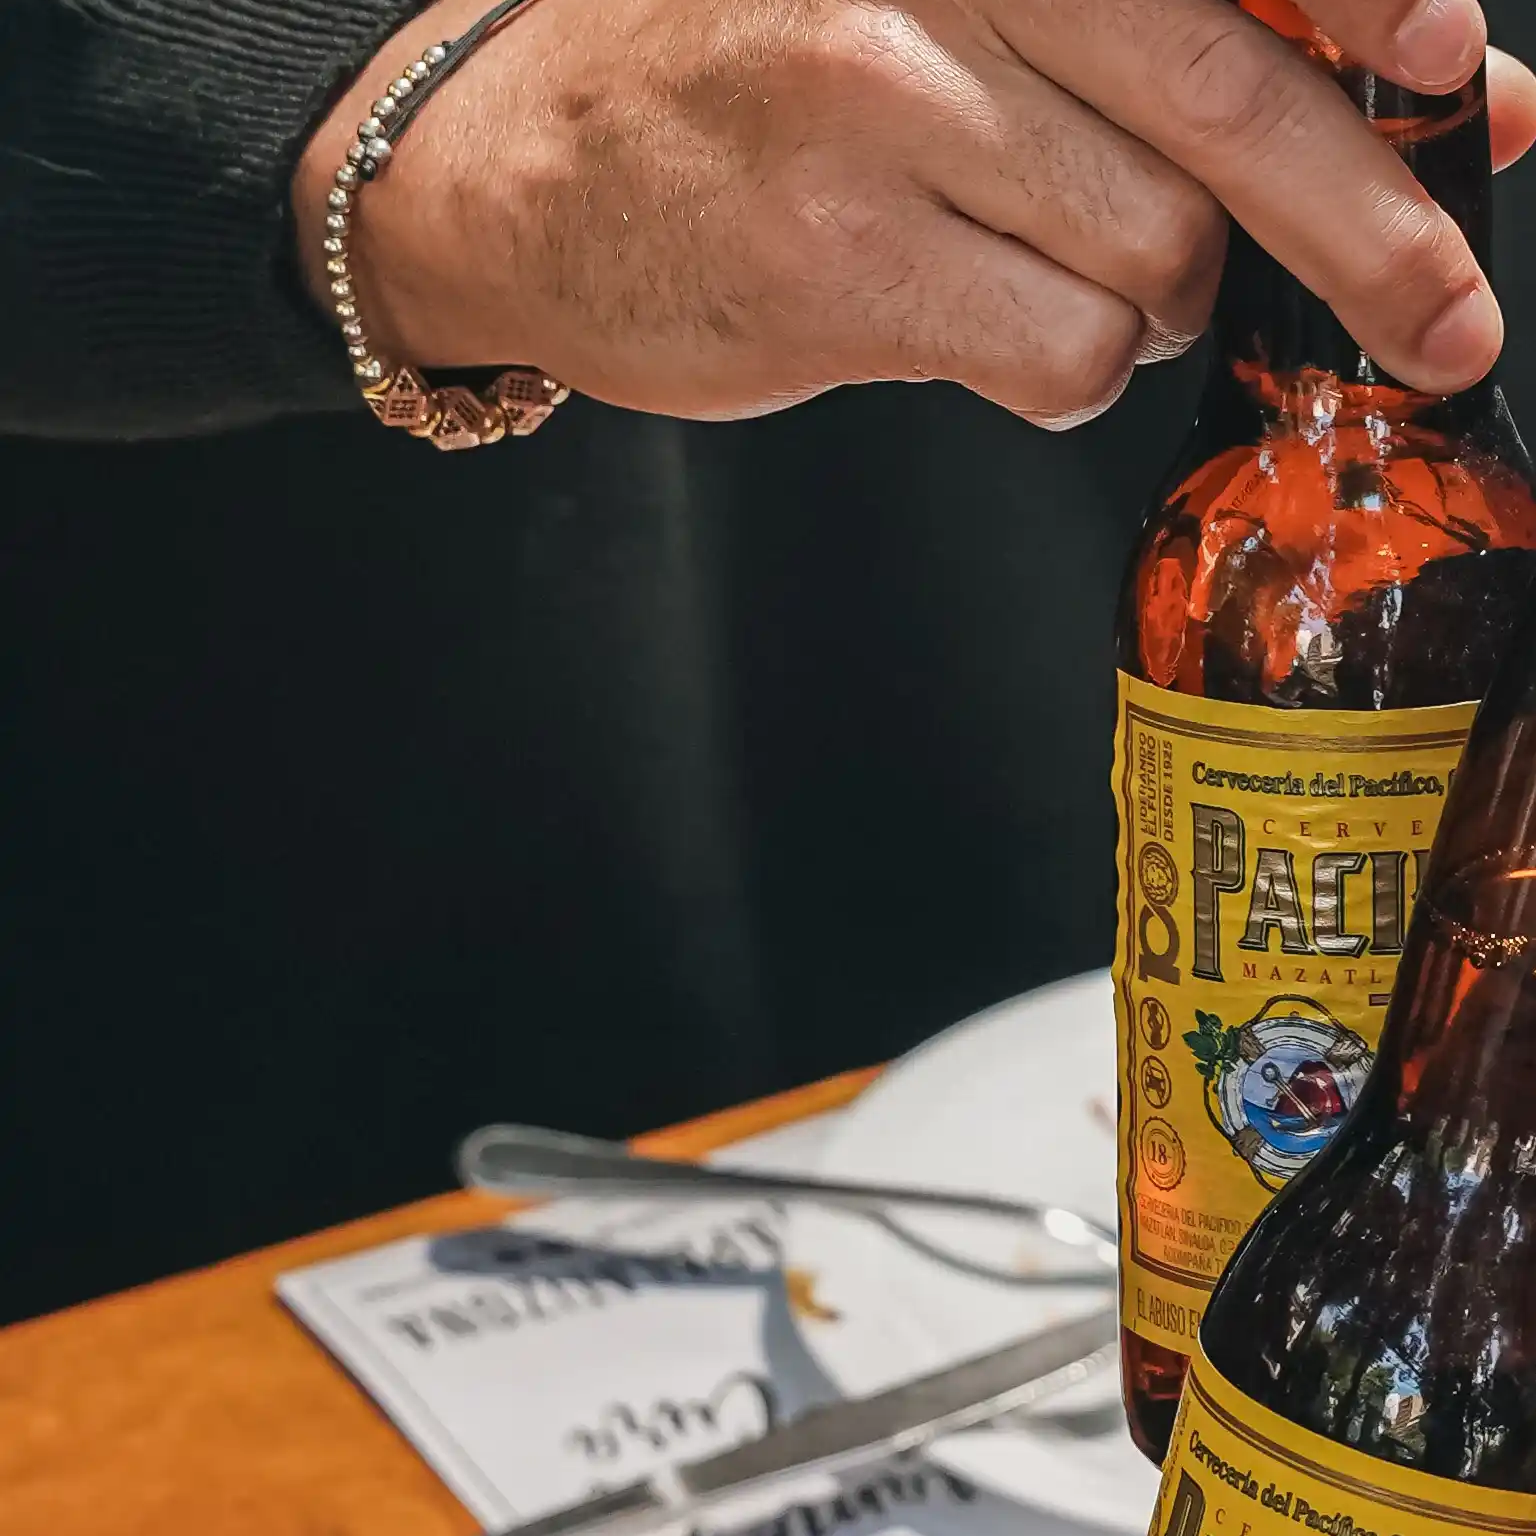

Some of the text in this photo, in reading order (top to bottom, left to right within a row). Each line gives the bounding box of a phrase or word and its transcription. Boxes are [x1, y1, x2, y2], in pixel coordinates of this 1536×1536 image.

[1147, 735, 1157, 813] FUTURO
[1163, 739, 1174, 842] DESDE 1925
[1309, 772, 1346, 797] del
[1263, 819, 1424, 838] CERVE
[1190, 802, 1430, 983] PACI
[1243, 962, 1382, 985] MAZATL
[1182, 1207, 1197, 1229] DEL
[1137, 1287, 1148, 1321] EL
[1149, 1294, 1186, 1336] ABUSO
[1261, 1483, 1294, 1516] del
